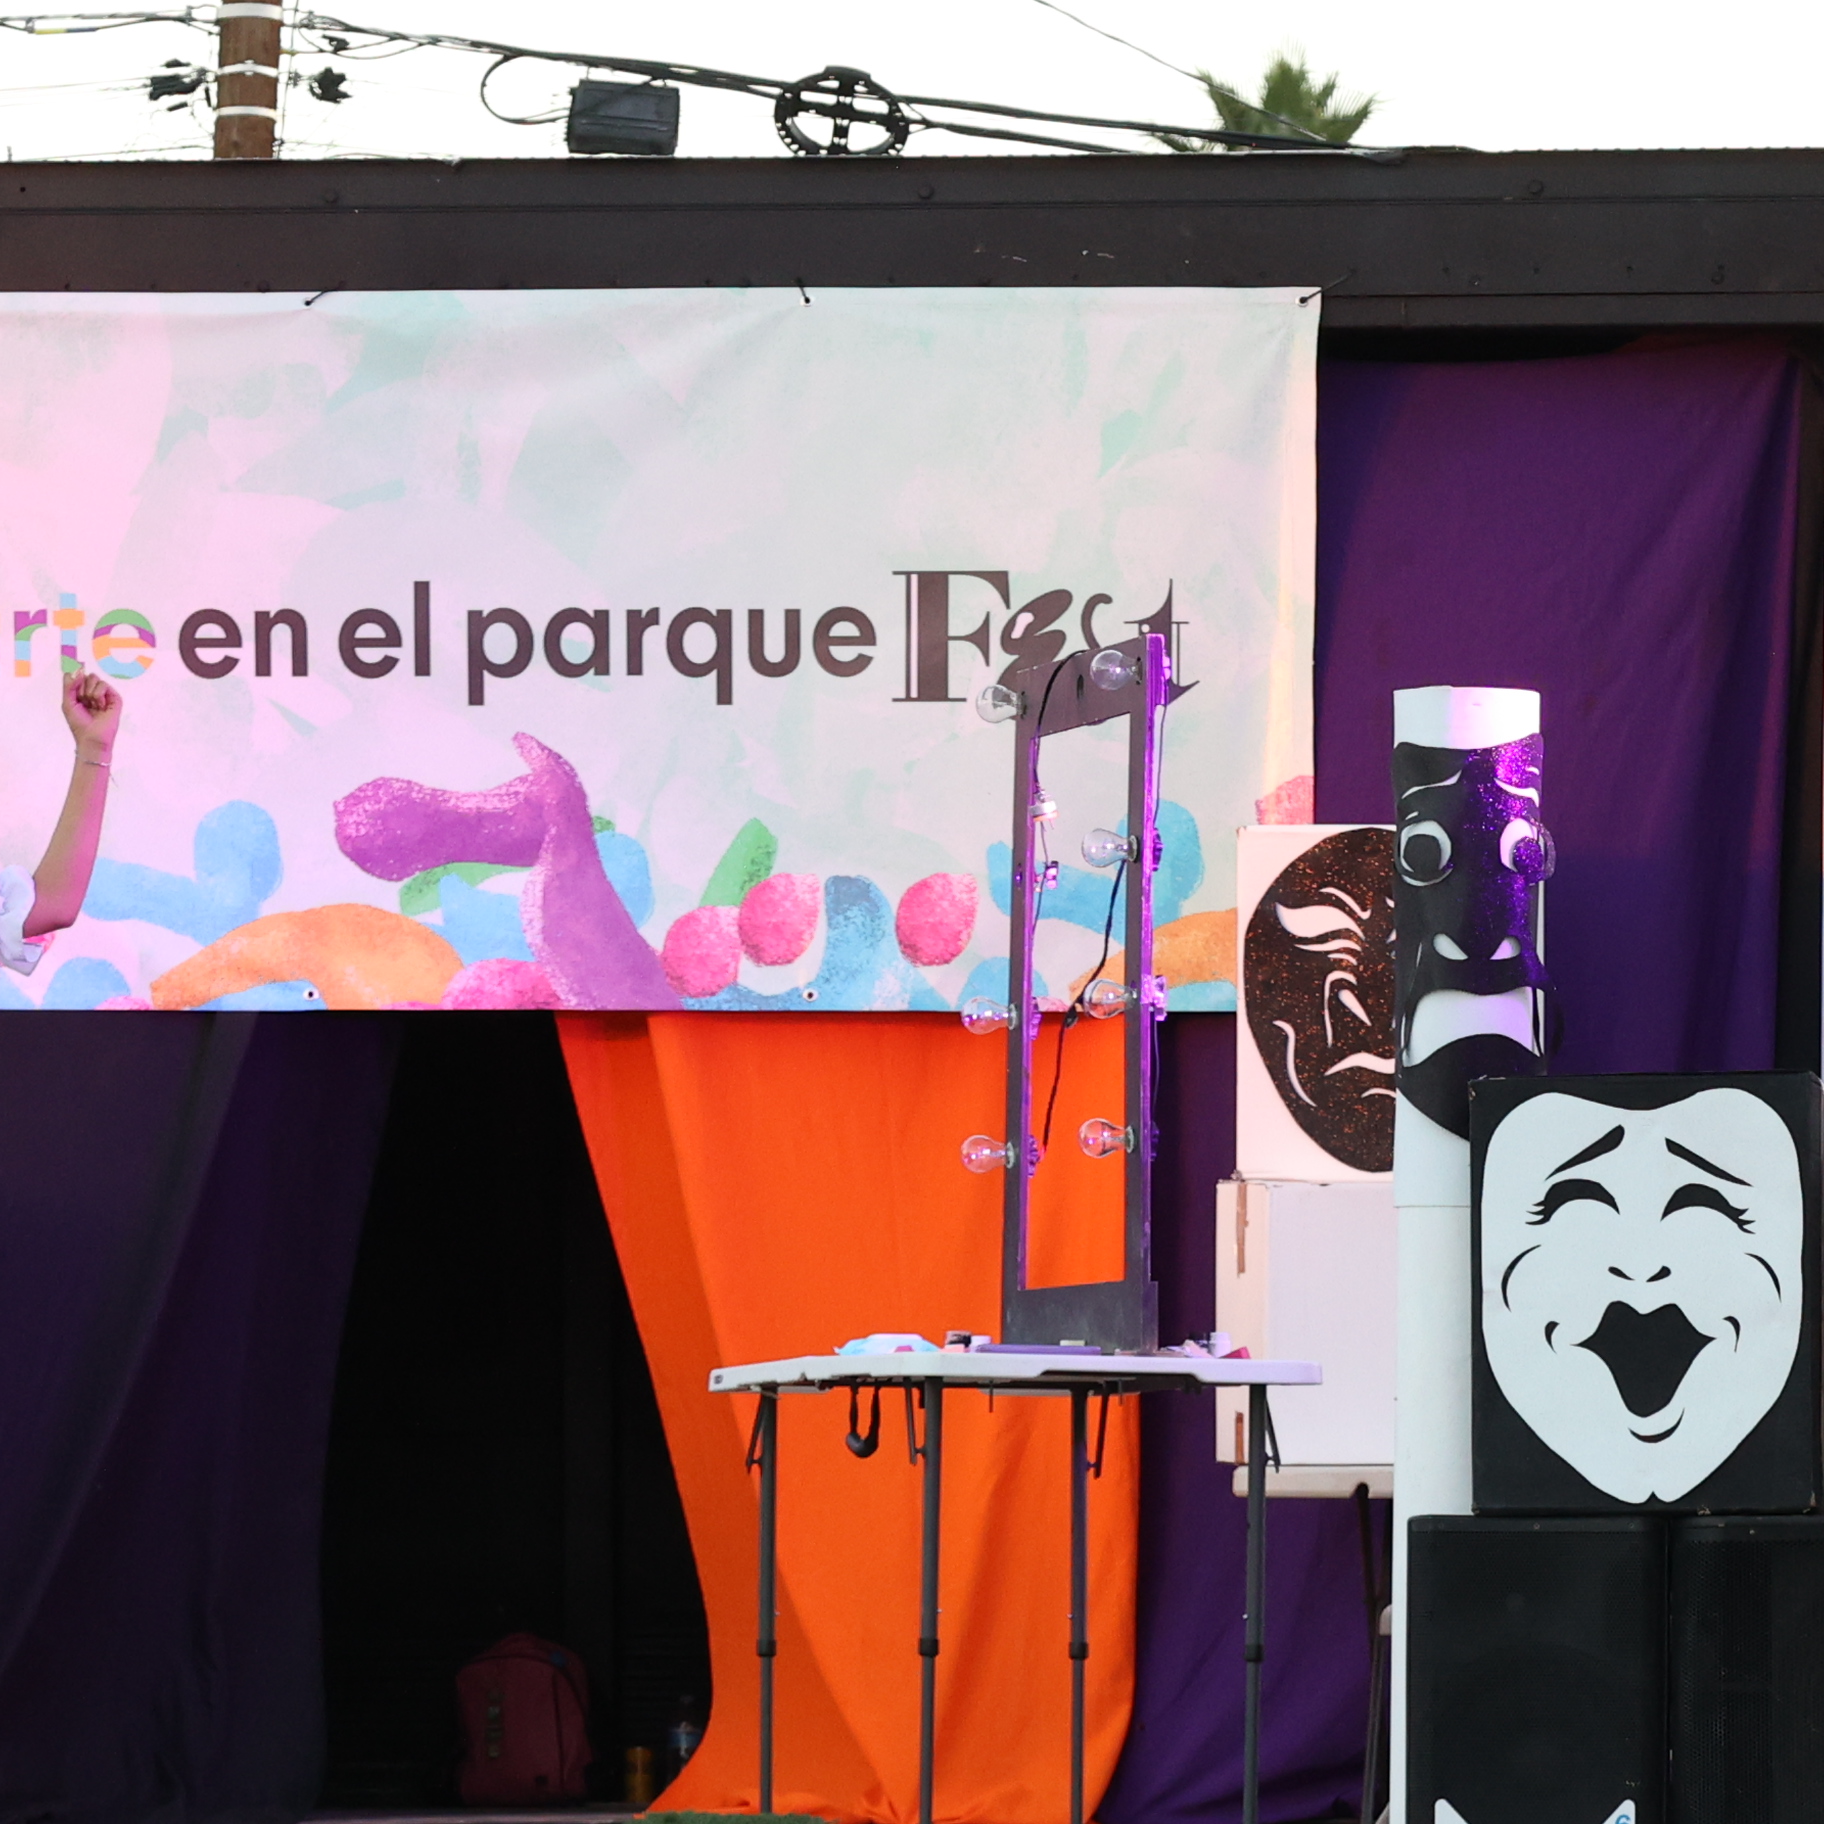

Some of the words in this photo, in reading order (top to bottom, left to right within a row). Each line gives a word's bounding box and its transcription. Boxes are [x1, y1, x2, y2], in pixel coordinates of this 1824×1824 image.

[178, 605, 309, 679] en
[338, 580, 431, 679] el
[467, 605, 878, 707] parque
